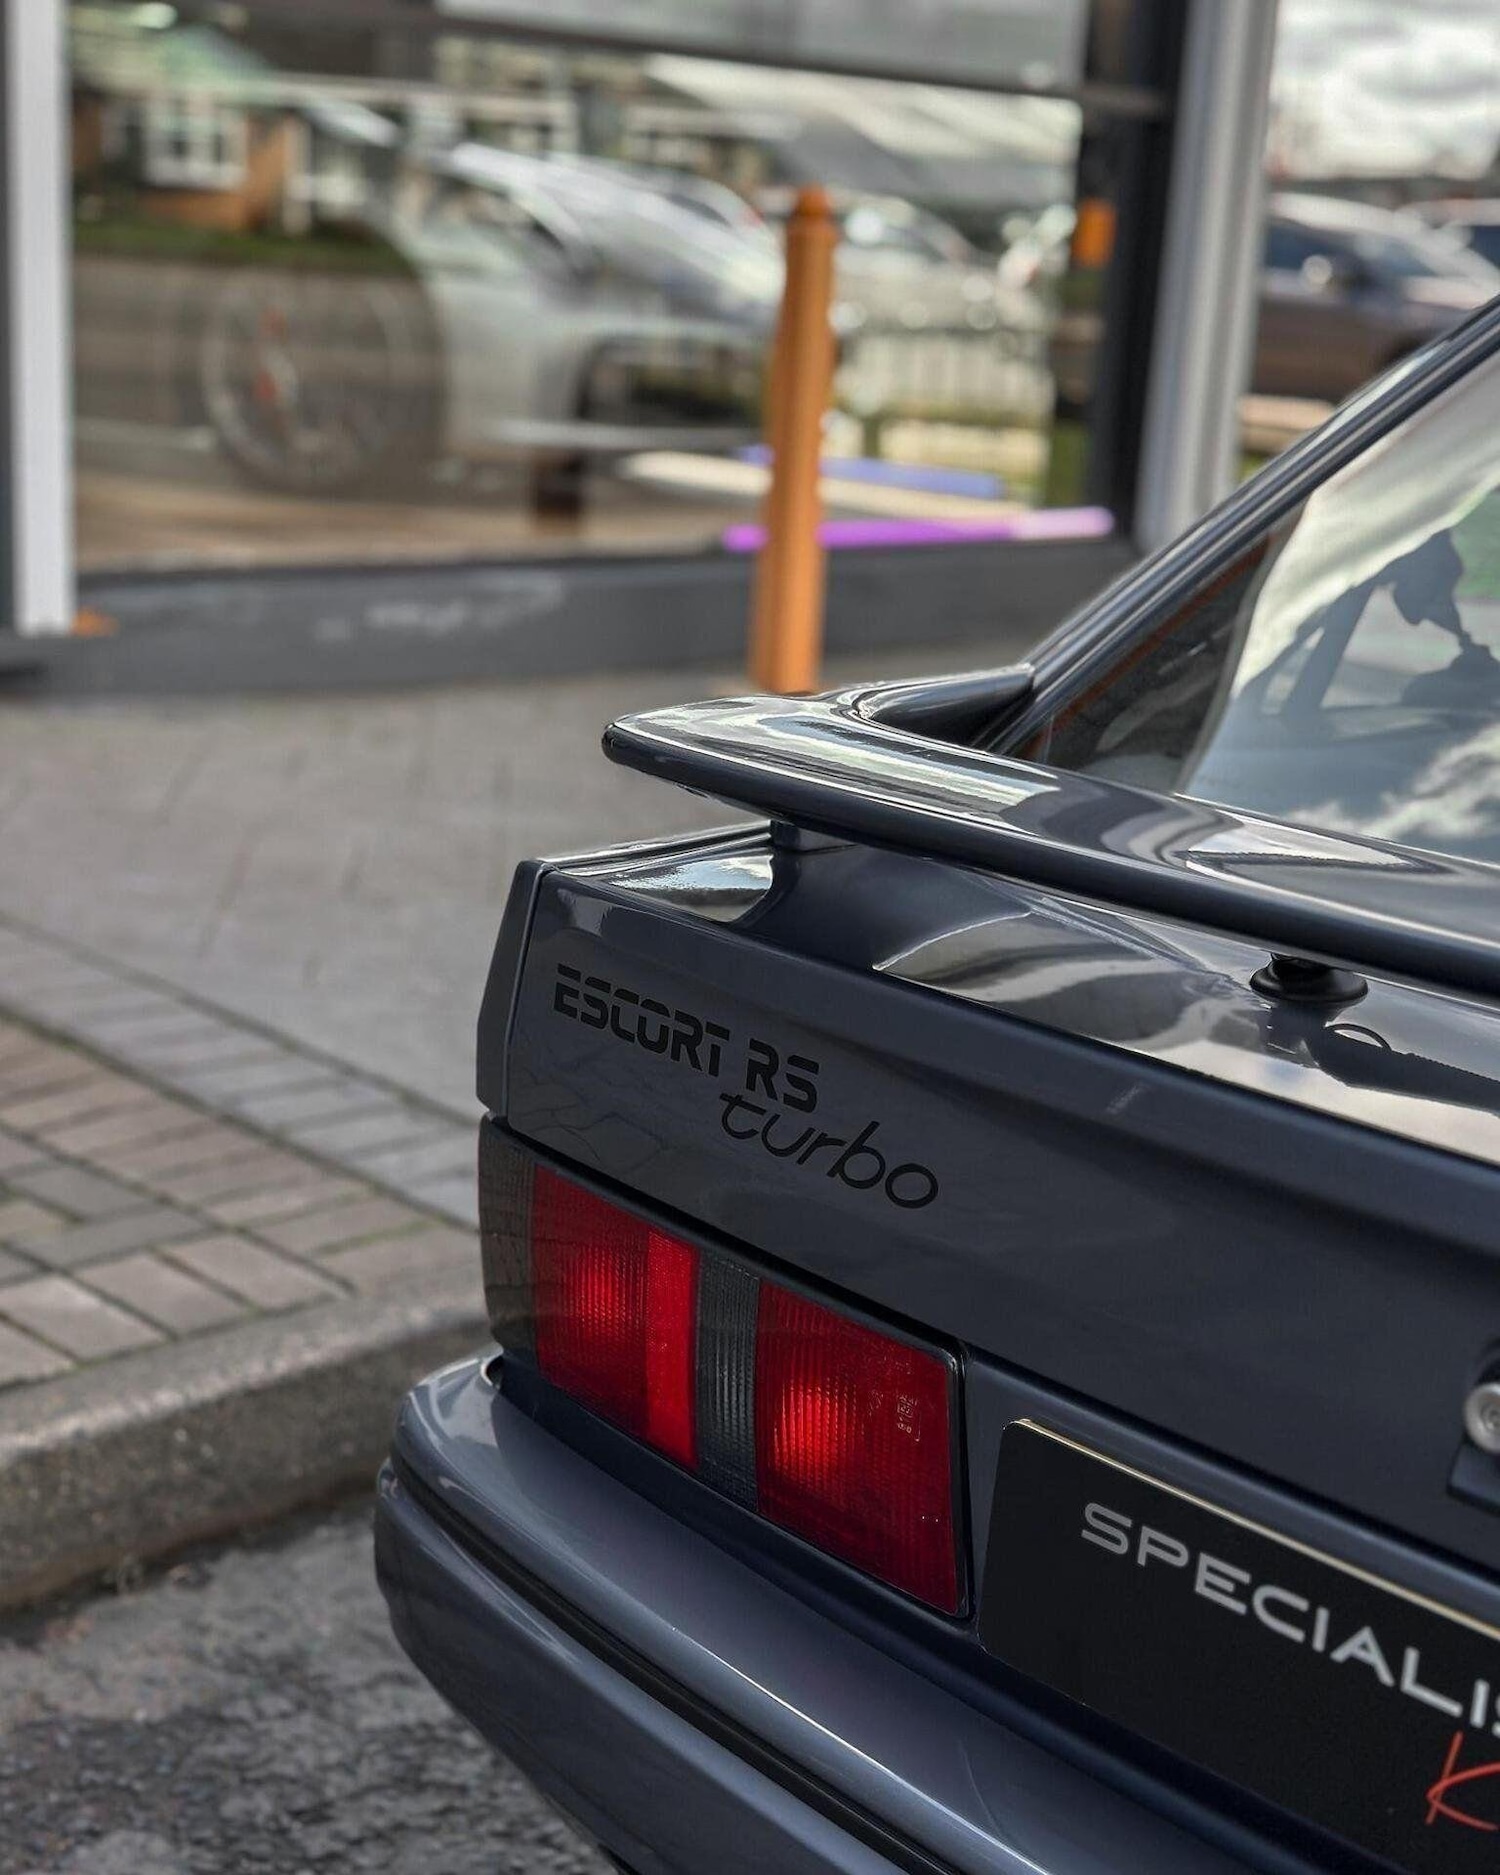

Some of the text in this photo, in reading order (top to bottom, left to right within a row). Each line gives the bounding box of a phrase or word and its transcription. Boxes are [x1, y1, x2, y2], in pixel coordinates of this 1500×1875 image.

[554, 964, 820, 1113] ESCORT RS
[719, 1092, 939, 1209] turbo
[1081, 1502, 1500, 1737] SPECIALI
